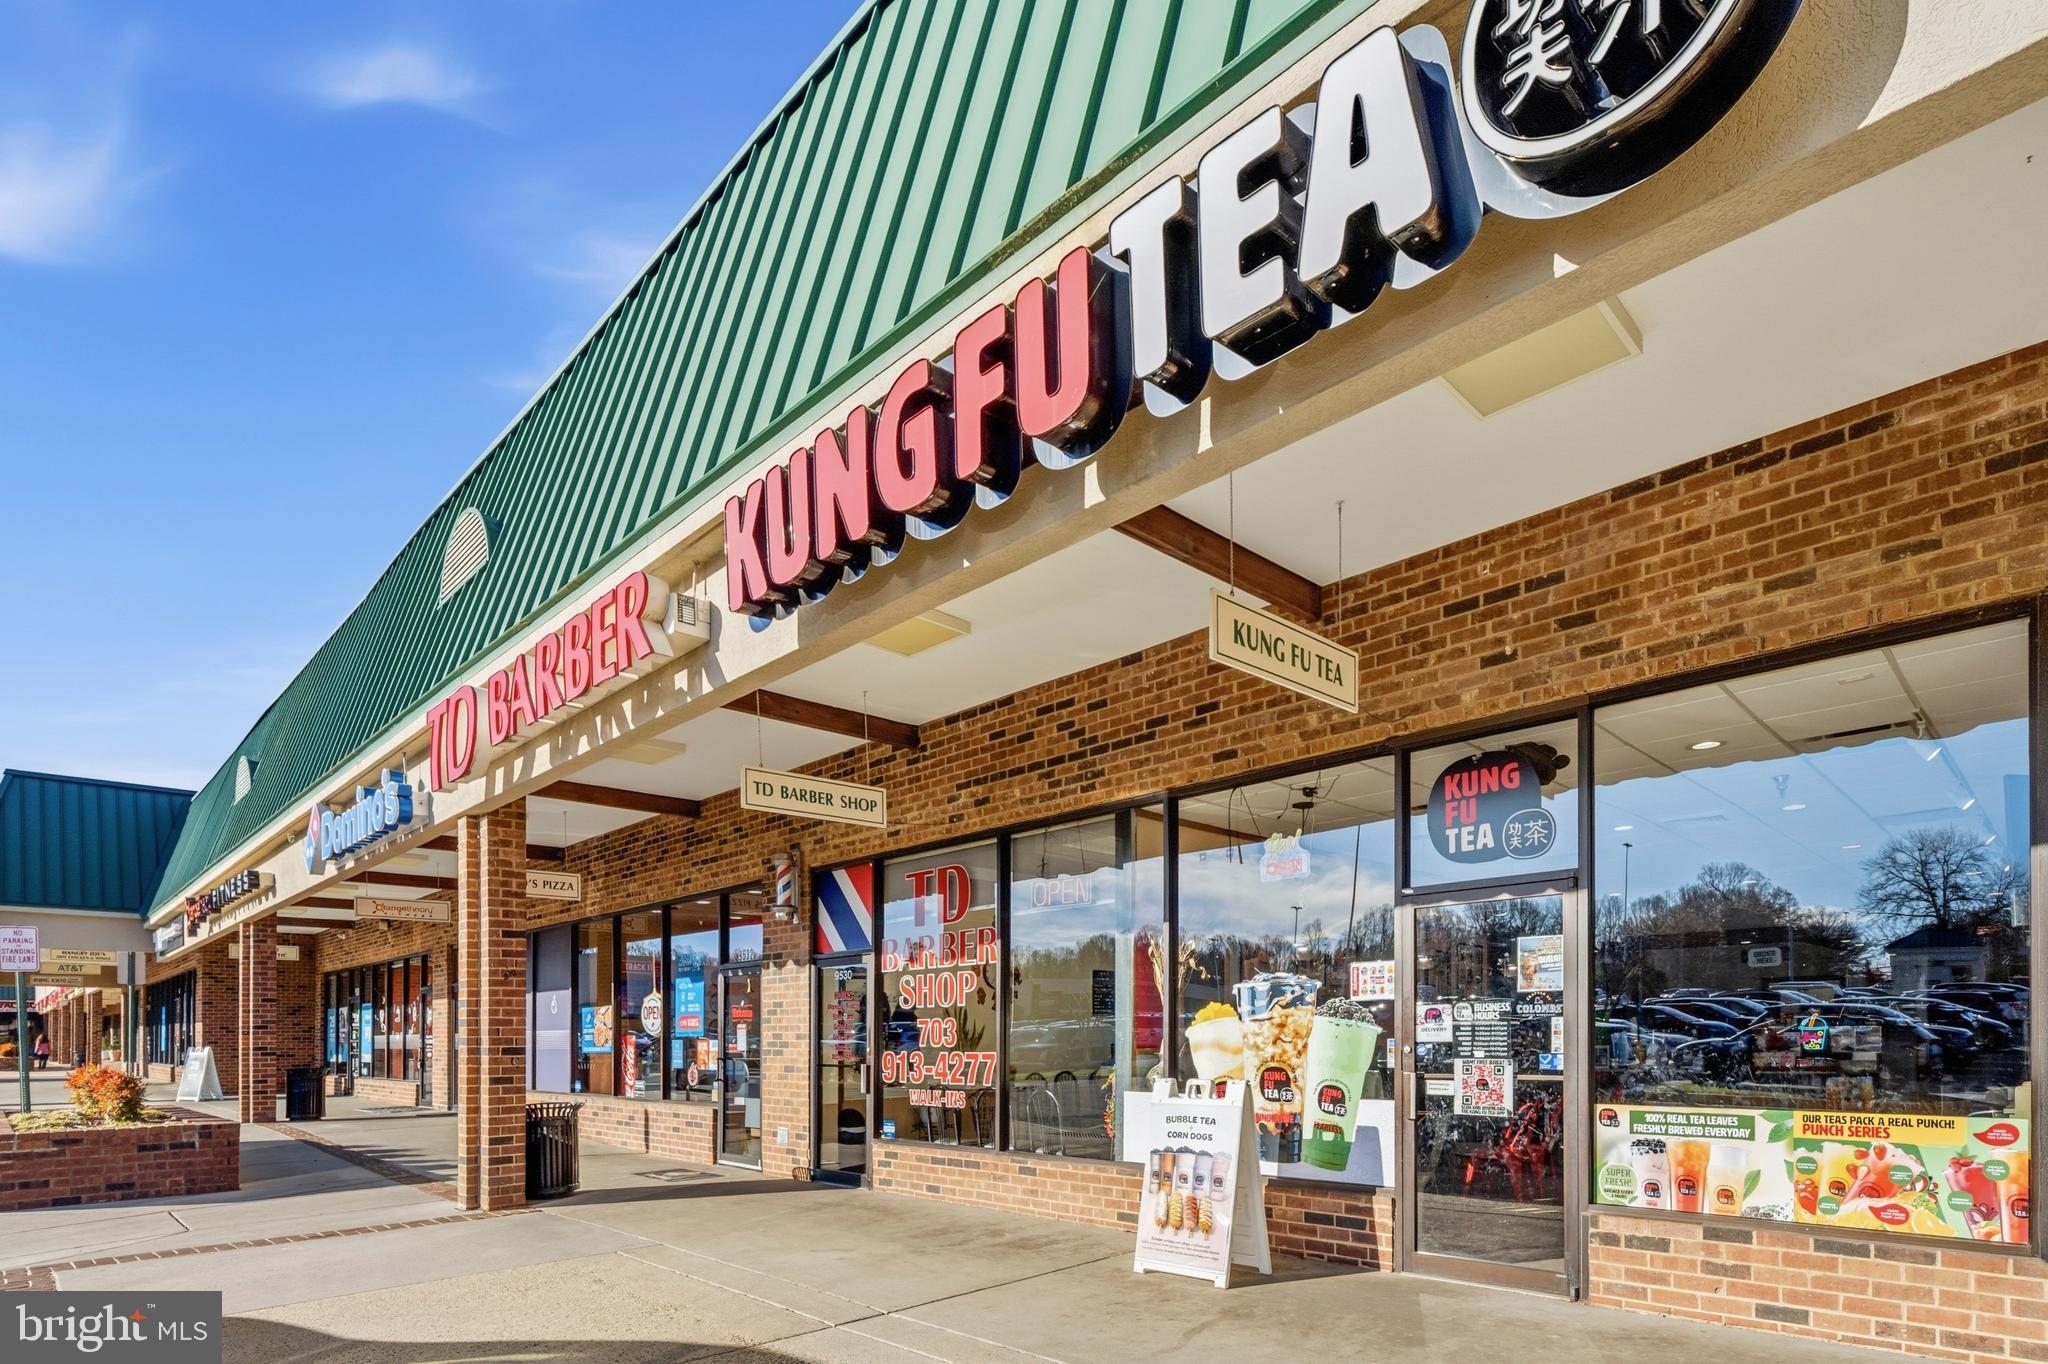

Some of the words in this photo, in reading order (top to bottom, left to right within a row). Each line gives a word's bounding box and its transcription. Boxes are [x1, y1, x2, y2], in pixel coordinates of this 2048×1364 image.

[723, 358, 940, 610] KUNG
[955, 247, 1097, 481] FU
[1109, 25, 1432, 379] TEA
[1233, 618, 1285, 663] KUNG
[1291, 643, 1311, 672] FU
[1315, 654, 1343, 687] TEA
[427, 685, 478, 792] TD
[487, 571, 654, 746] BARBER
[1444, 762, 1520, 800] KUNG
[753, 780, 774, 797] TD
[780, 785, 834, 807] BARBER
[840, 795, 878, 812] SHOP
[321, 768, 400, 861] Domino's
[1445, 797, 1477, 827] FU
[1445, 823, 1495, 854] TEA
[212, 869, 249, 909] FITNESS
[543, 880, 574, 891] PIZZA
[1034, 877, 1090, 906] OPEN
[905, 864, 972, 927] TD
[881, 926, 998, 973] BARBER
[18, 955, 35, 963] LANE
[57, 964, 84, 972] AT&T
[834, 970, 853, 980] 9530
[898, 970, 977, 1010] SHOP
[644, 1005, 662, 1021] OPEN
[1473, 1002, 1511, 1012] BUSINESS
[1516, 1004, 1563, 1014] COLOMBE
[1474, 1011, 1500, 1020] HOURS
[917, 1018, 957, 1048] 703
[882, 1050, 997, 1087] 913-4277
[1264, 1071, 1286, 1081] KUNG
[1264, 1080, 1274, 1089] FU
[909, 1088, 967, 1109] WALK-INS
[1264, 1088, 1279, 1099] TEA
[1321, 1095, 1331, 1103] FU
[1322, 1087, 1342, 1098] KUNG
[1320, 1102, 1334, 1112] TEA
[1166, 1115, 1198, 1124] BUBBLE
[1200, 1116, 1217, 1126] TEA
[1645, 1113, 1666, 1123] 100%
[1666, 1114, 1688, 1124] REAL
[1690, 1115, 1705, 1124] TEA
[1706, 1116, 1739, 1126] LEAVES
[1802, 1114, 1822, 1124] OUR
[1824, 1115, 1847, 1125] TEAS
[1850, 1116, 1874, 1126] PACK
[1878, 1117, 1886, 1126] A
[1888, 1117, 1914, 1128] REAL
[1917, 1118, 1955, 1129] PUNCH!
[1167, 1131, 1189, 1139] CORN
[1190, 1132, 1213, 1141] DOGS
[1633, 1123, 1667, 1134] FRESHLY
[1668, 1125, 1703, 1136] BREWED
[1704, 1126, 1750, 1138] EVERYDAY
[1802, 1124, 1844, 1137] PUNCH
[1847, 1126, 1891, 1139] SERIES
[1606, 1168, 1631, 1177] SUPER
[1605, 1177, 1632, 1187] FRESH!
